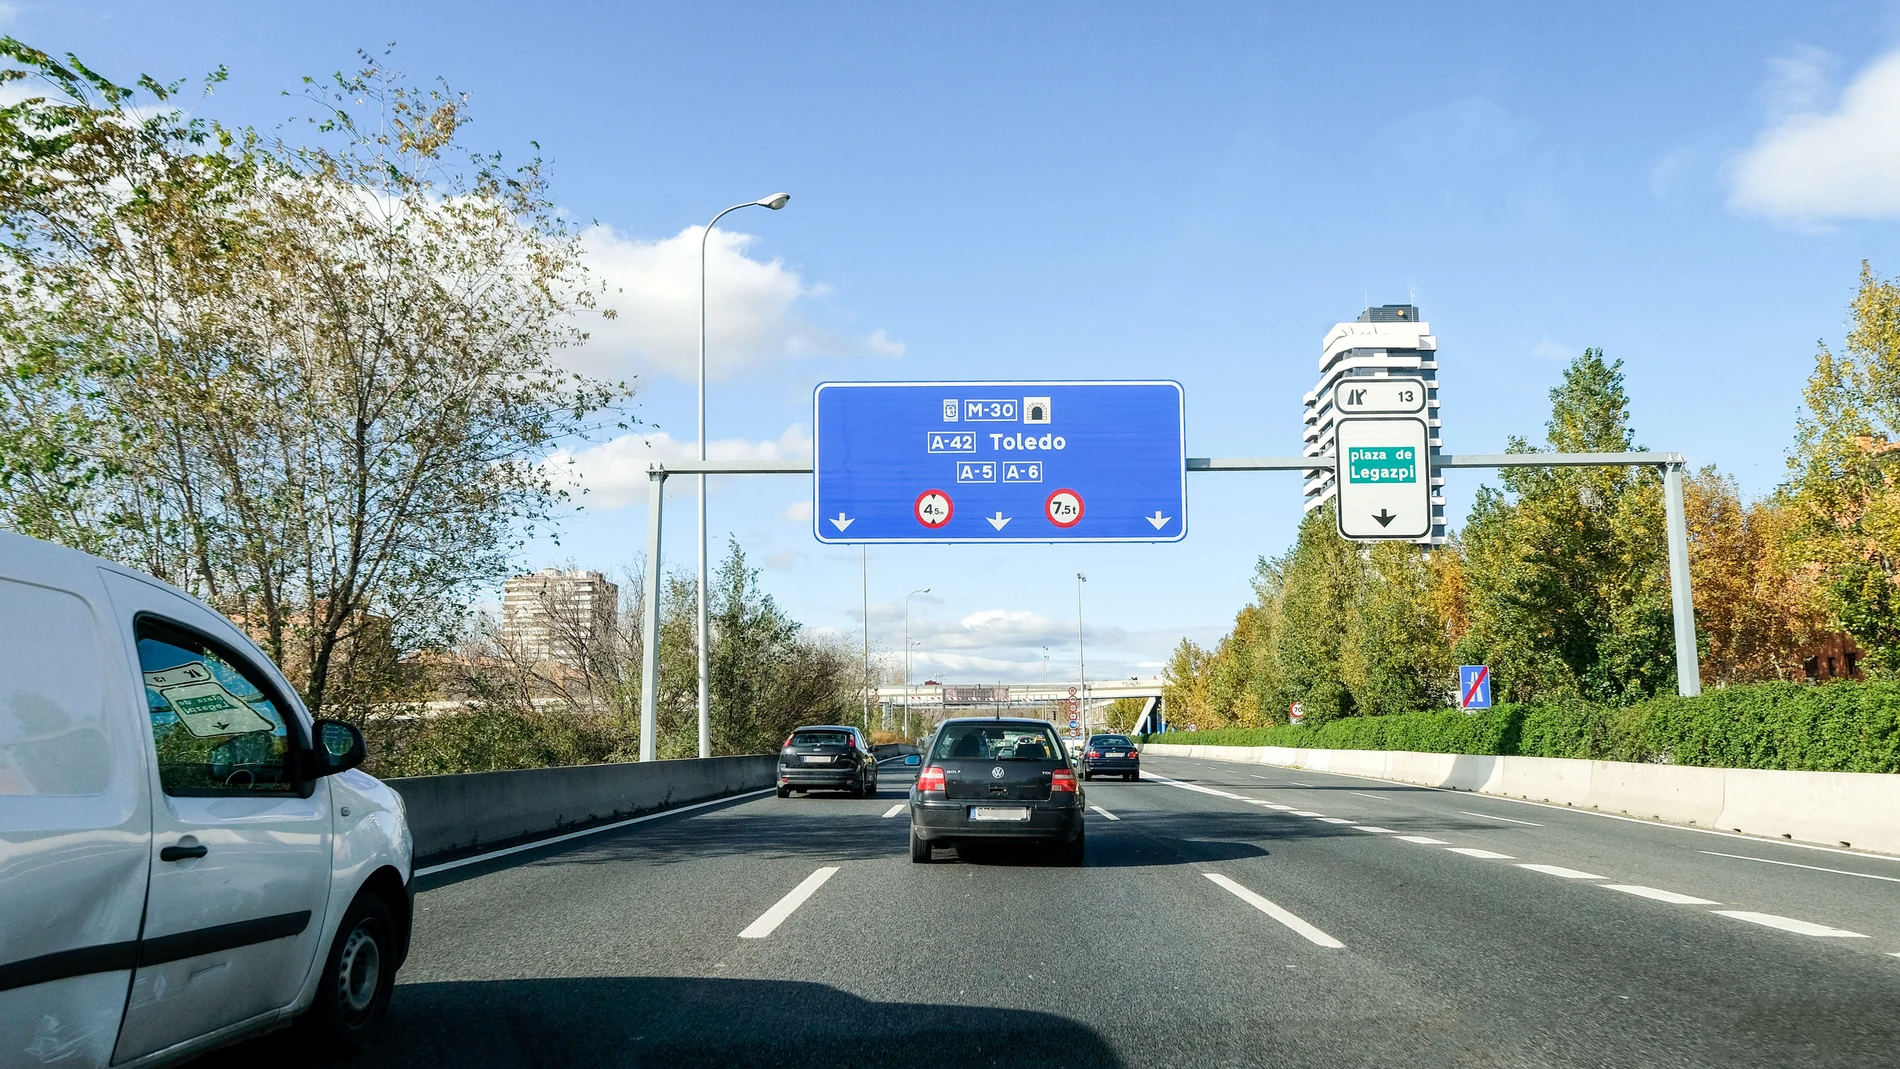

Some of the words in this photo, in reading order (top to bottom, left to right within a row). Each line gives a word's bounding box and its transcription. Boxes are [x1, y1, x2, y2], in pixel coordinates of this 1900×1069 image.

[1398, 390, 1414, 403] 13
[968, 403, 1014, 417] M-30
[931, 435, 973, 450] A-42
[990, 433, 1066, 451] Toledo
[1351, 449, 1387, 462] plaza
[1395, 449, 1412, 460] de
[960, 465, 993, 479] A-5
[1006, 465, 1039, 479] A-6
[1351, 465, 1414, 481] Legazpi
